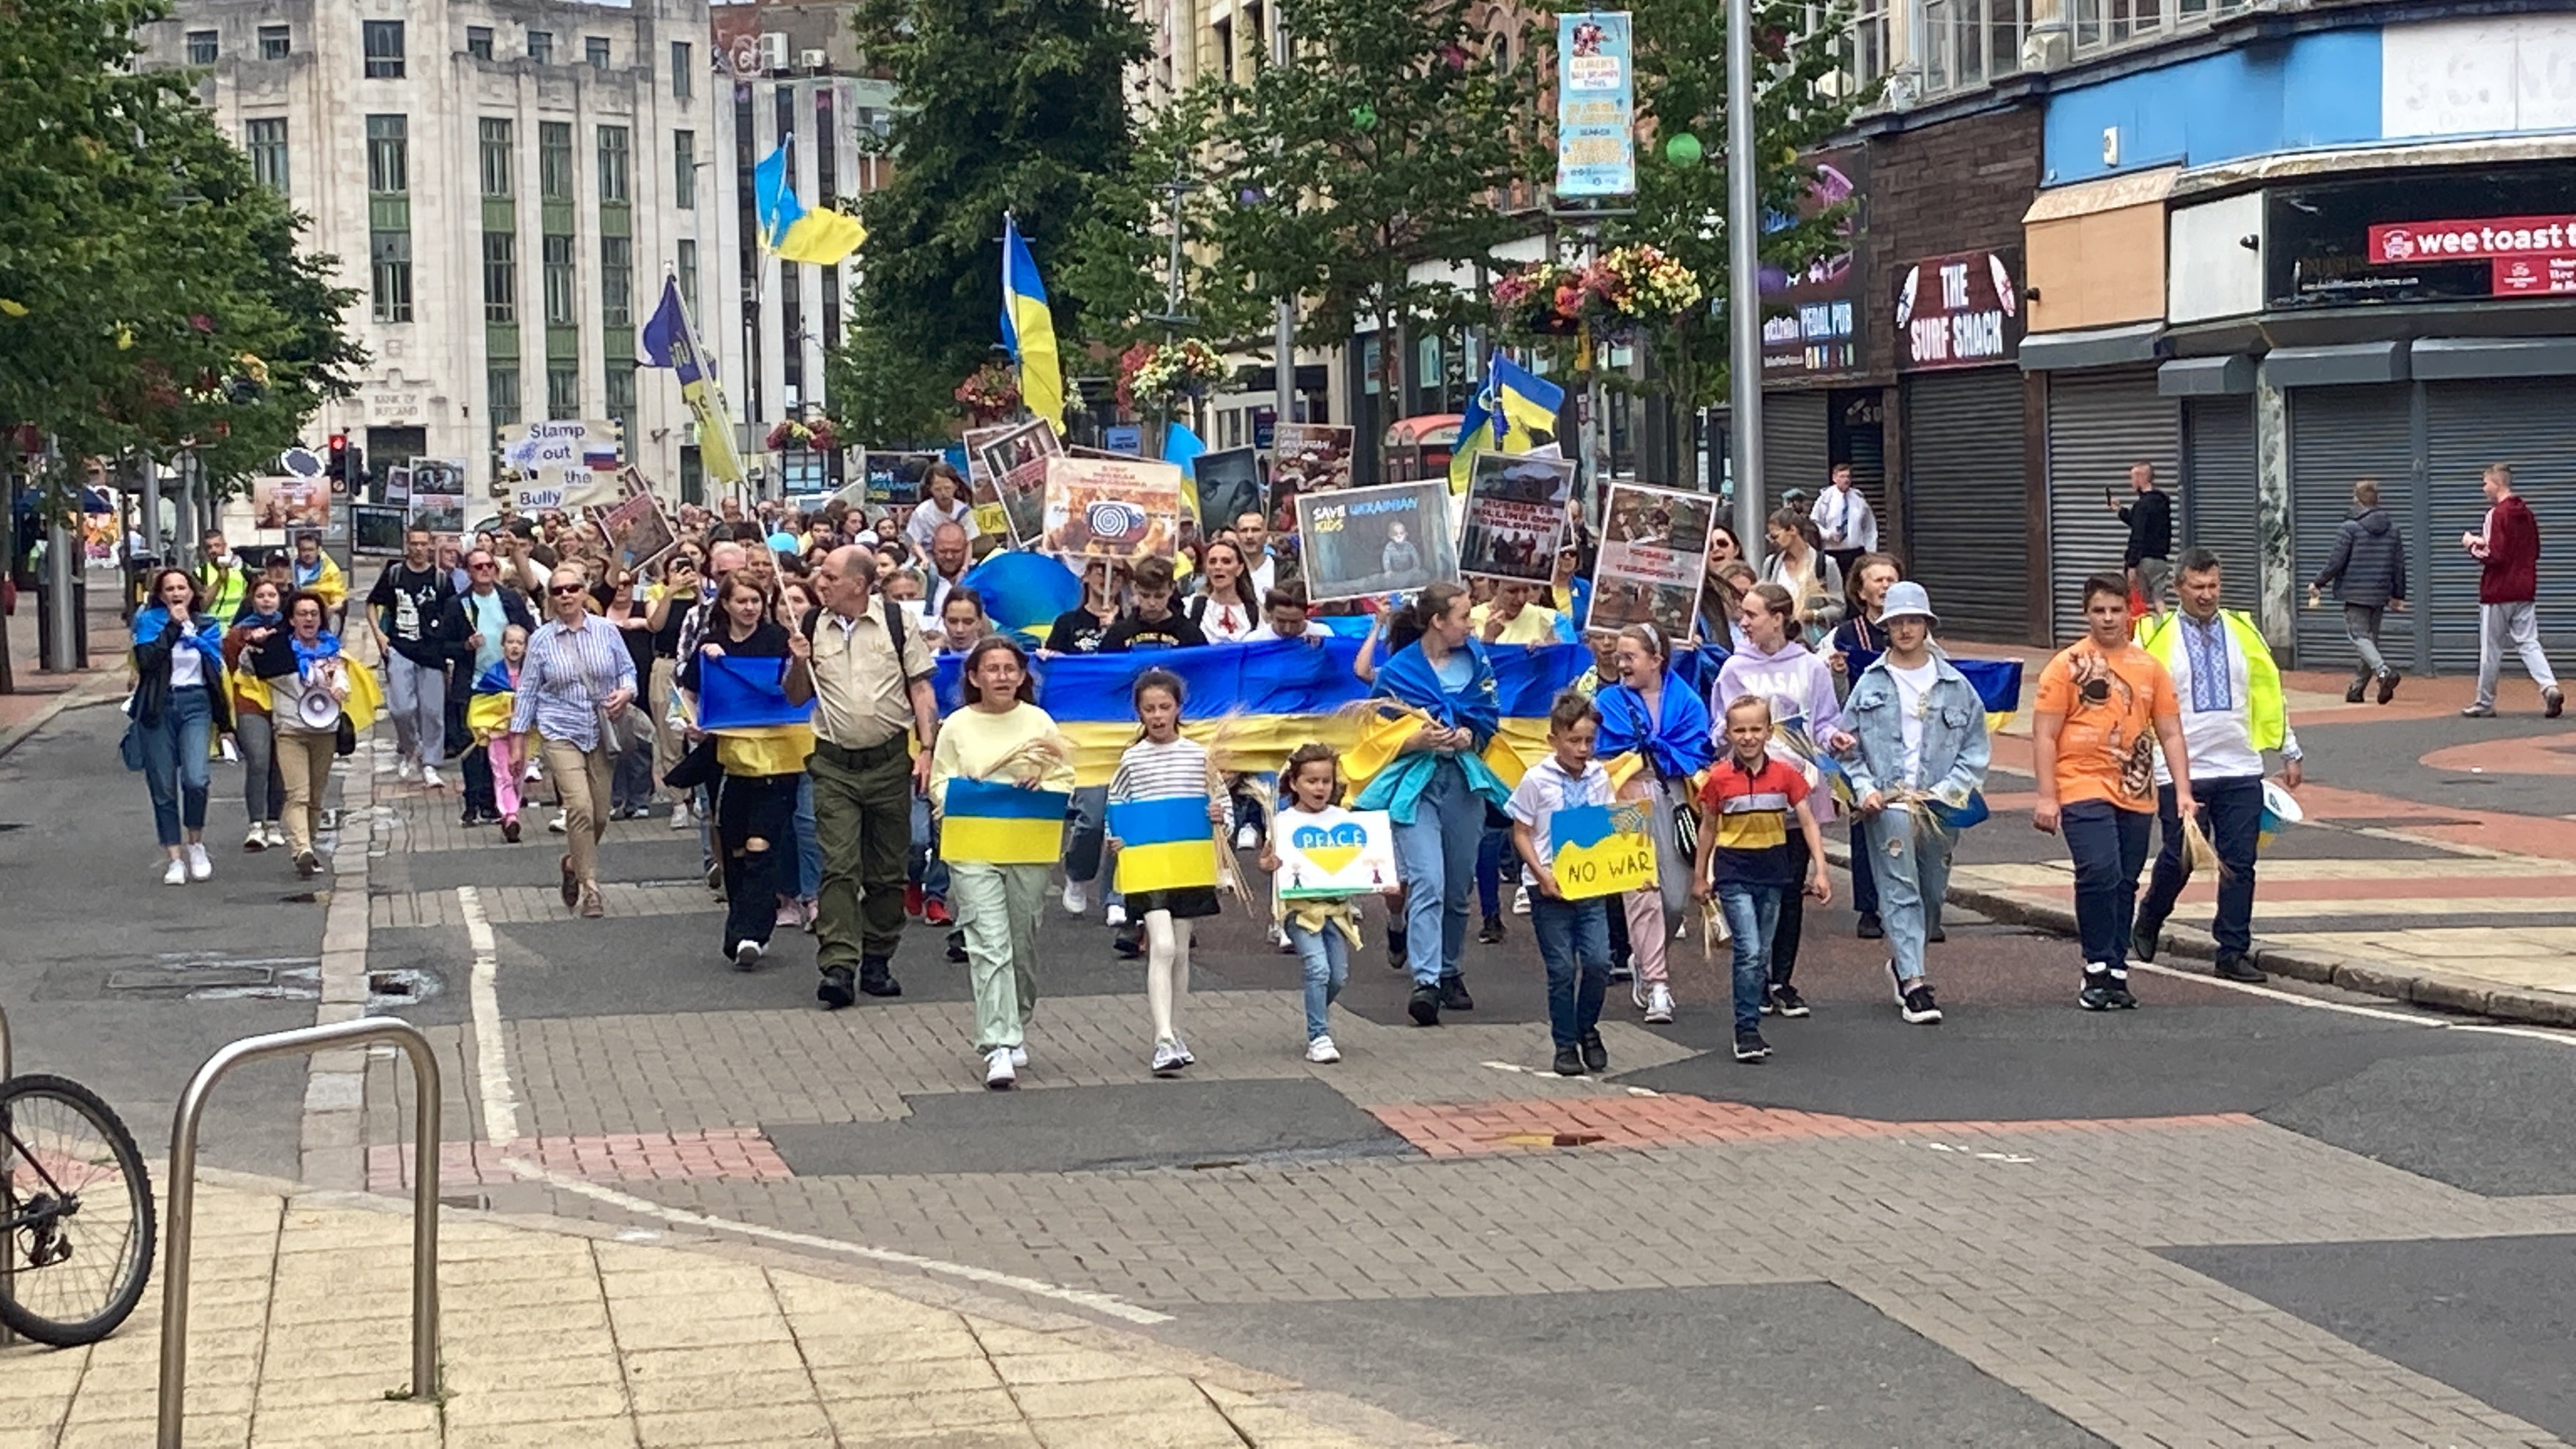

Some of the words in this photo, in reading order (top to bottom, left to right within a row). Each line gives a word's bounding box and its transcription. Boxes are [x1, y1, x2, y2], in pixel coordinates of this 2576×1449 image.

[2416, 231, 2479, 254] wee
[2481, 220, 2563, 252] toast
[1940, 263, 1969, 310] THE
[1800, 306, 1832, 337] PEDAL
[1832, 302, 1853, 336] PUB
[1911, 316, 1950, 362] SURF
[1952, 309, 2004, 359] SHACK
[531, 423, 586, 440] Stamp
[542, 445, 572, 460] out
[564, 469, 593, 484] the
[519, 490, 562, 507] Bully
[1482, 499, 1536, 513] RUSSIA
[1312, 503, 1347, 522] SAVE
[1349, 496, 1419, 517] UKRAINIAN
[1472, 506, 1528, 522] KILLING
[1530, 515, 1562, 524] OUR
[1314, 518, 1344, 533] KIDS
[1479, 517, 1551, 533] CHILDREN
[1742, 670, 1800, 697] NASA
[1303, 828, 1363, 849] PEACE
[1568, 861, 1597, 883] NO
[1607, 850, 1654, 879] WAR
